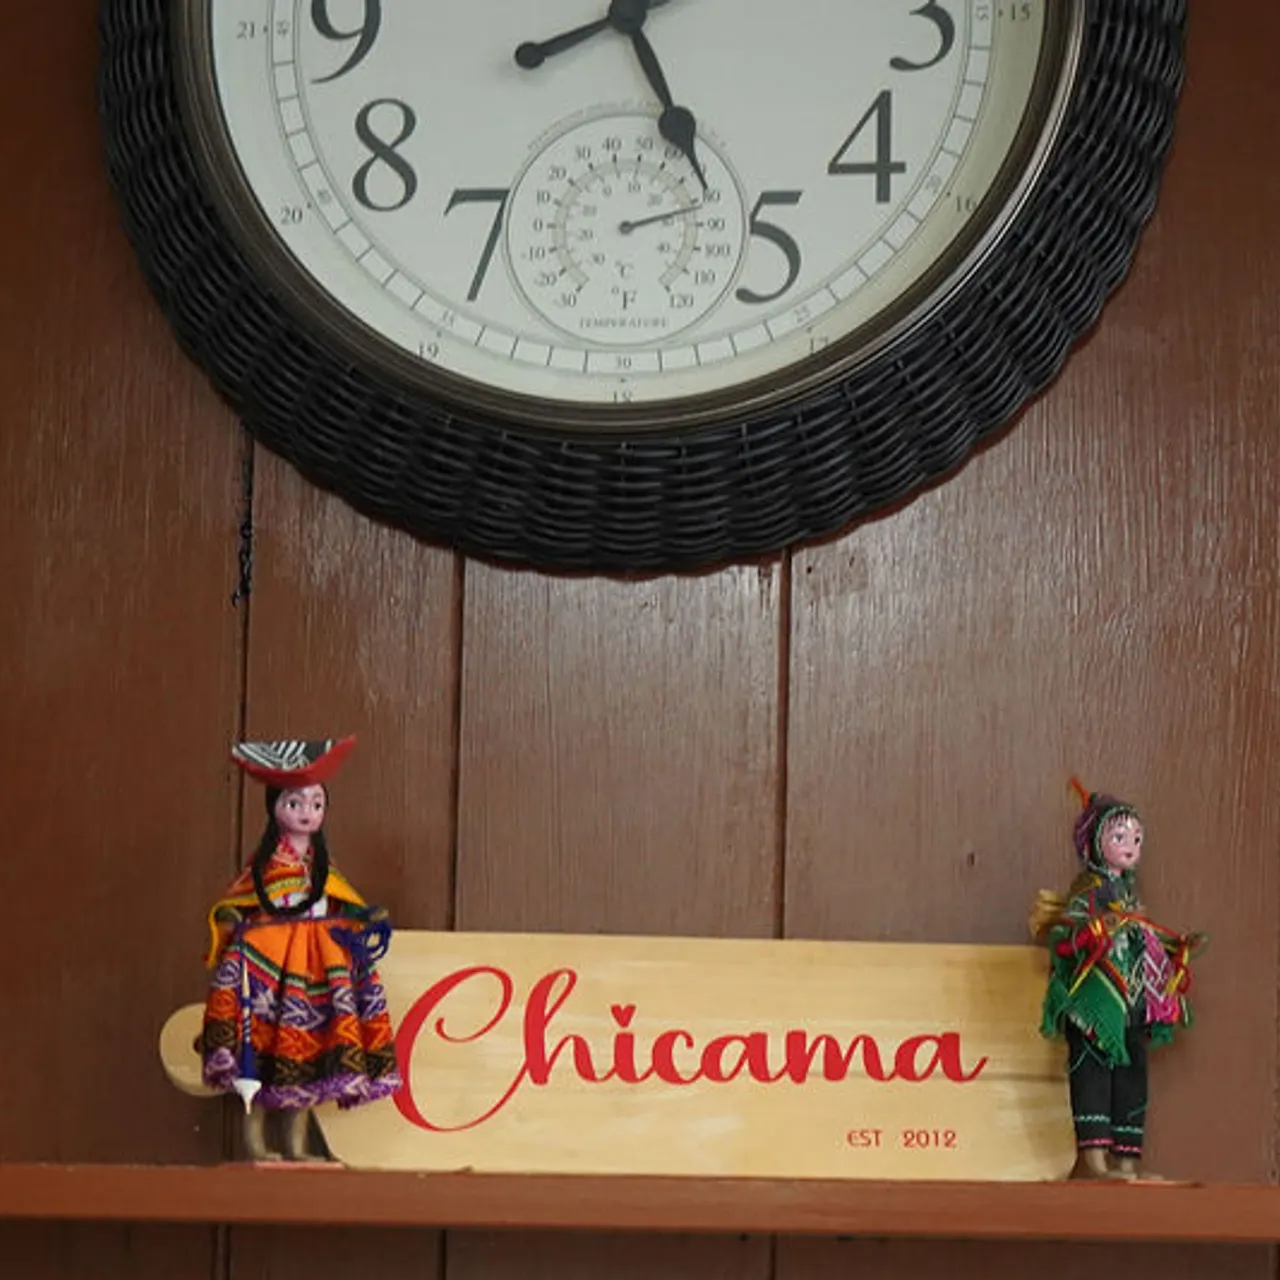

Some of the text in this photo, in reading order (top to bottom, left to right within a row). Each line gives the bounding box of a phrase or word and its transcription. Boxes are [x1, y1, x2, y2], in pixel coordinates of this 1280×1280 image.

[236, 22, 257, 39] 21
[311, 0, 382, 84] 9
[889, 0, 956, 72] 3
[1009, 3, 1031, 22] 15
[351, 98, 418, 213] 8
[827, 88, 907, 204] 4
[281, 206, 303, 226] 20
[443, 188, 510, 302] 7
[734, 189, 805, 305] 5
[392, 964, 988, 1133] Chicama
[846, 1129, 958, 1150] EST 2012
